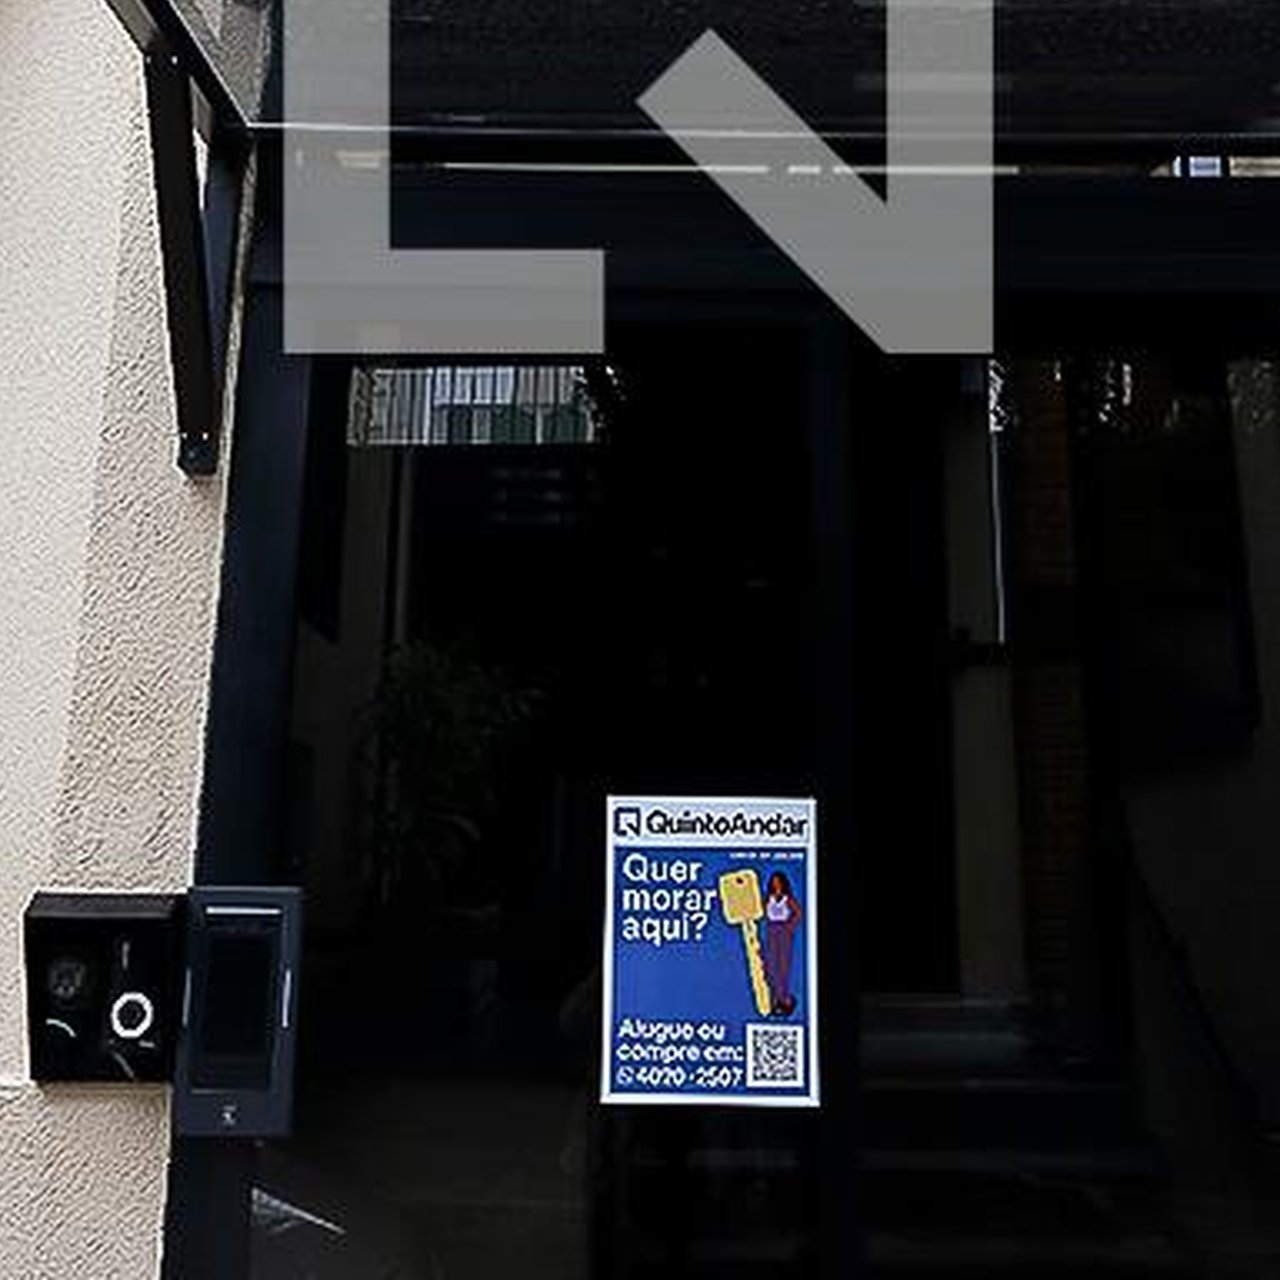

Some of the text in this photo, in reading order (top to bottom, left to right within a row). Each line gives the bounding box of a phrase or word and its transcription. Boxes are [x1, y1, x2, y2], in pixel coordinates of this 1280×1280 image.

[646, 810, 808, 837] QuintoAndar
[622, 853, 703, 882] Quer
[622, 888, 718, 912] morar
[622, 914, 708, 946] aqui?
[618, 1019, 725, 1044] Alugue ou
[616, 1043, 701, 1064] compre
